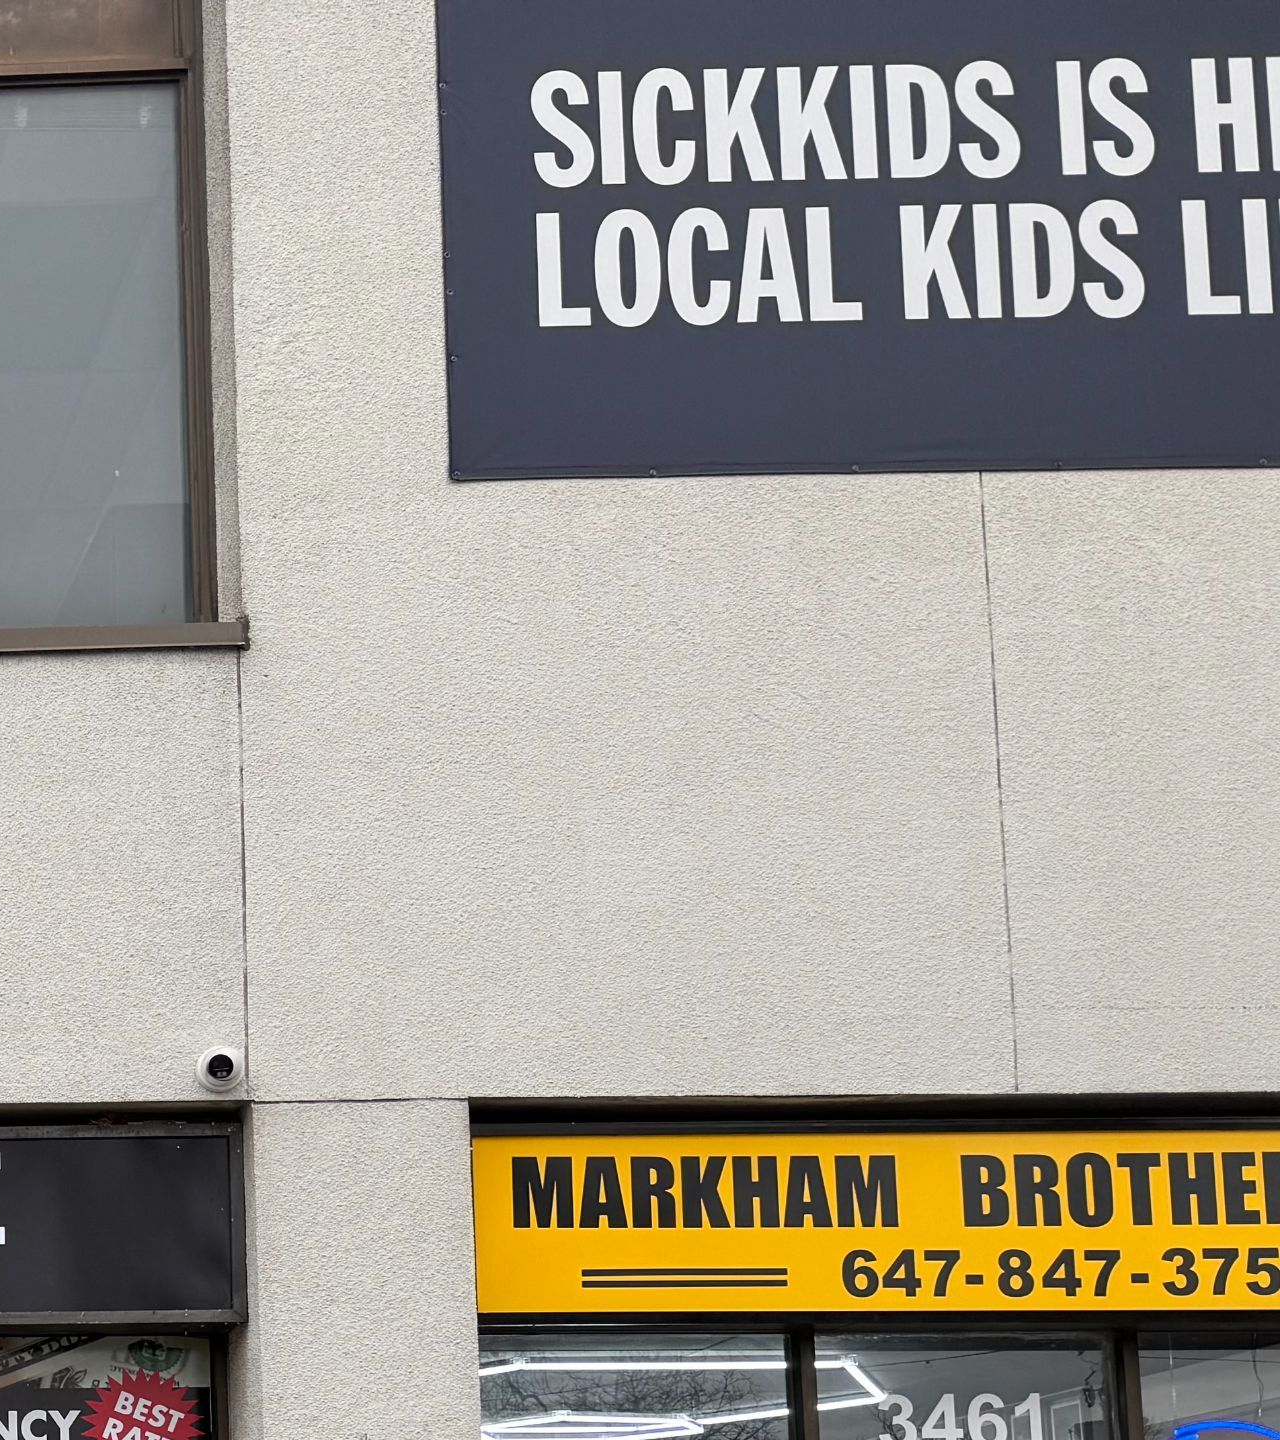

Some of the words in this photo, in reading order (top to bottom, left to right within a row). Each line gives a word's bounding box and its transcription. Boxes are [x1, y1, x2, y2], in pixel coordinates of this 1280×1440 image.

[529, 59, 1022, 188] SICKKIDS
[1056, 57, 1156, 178] IS
[535, 205, 864, 328] LOCAL
[899, 198, 1146, 319] KIDS
[1181, 197, 1280, 316] LI
[512, 1155, 900, 1229] MARKHAM
[840, 1246, 1280, 1299] 647-847-375
[114, 1391, 186, 1434] BEST
